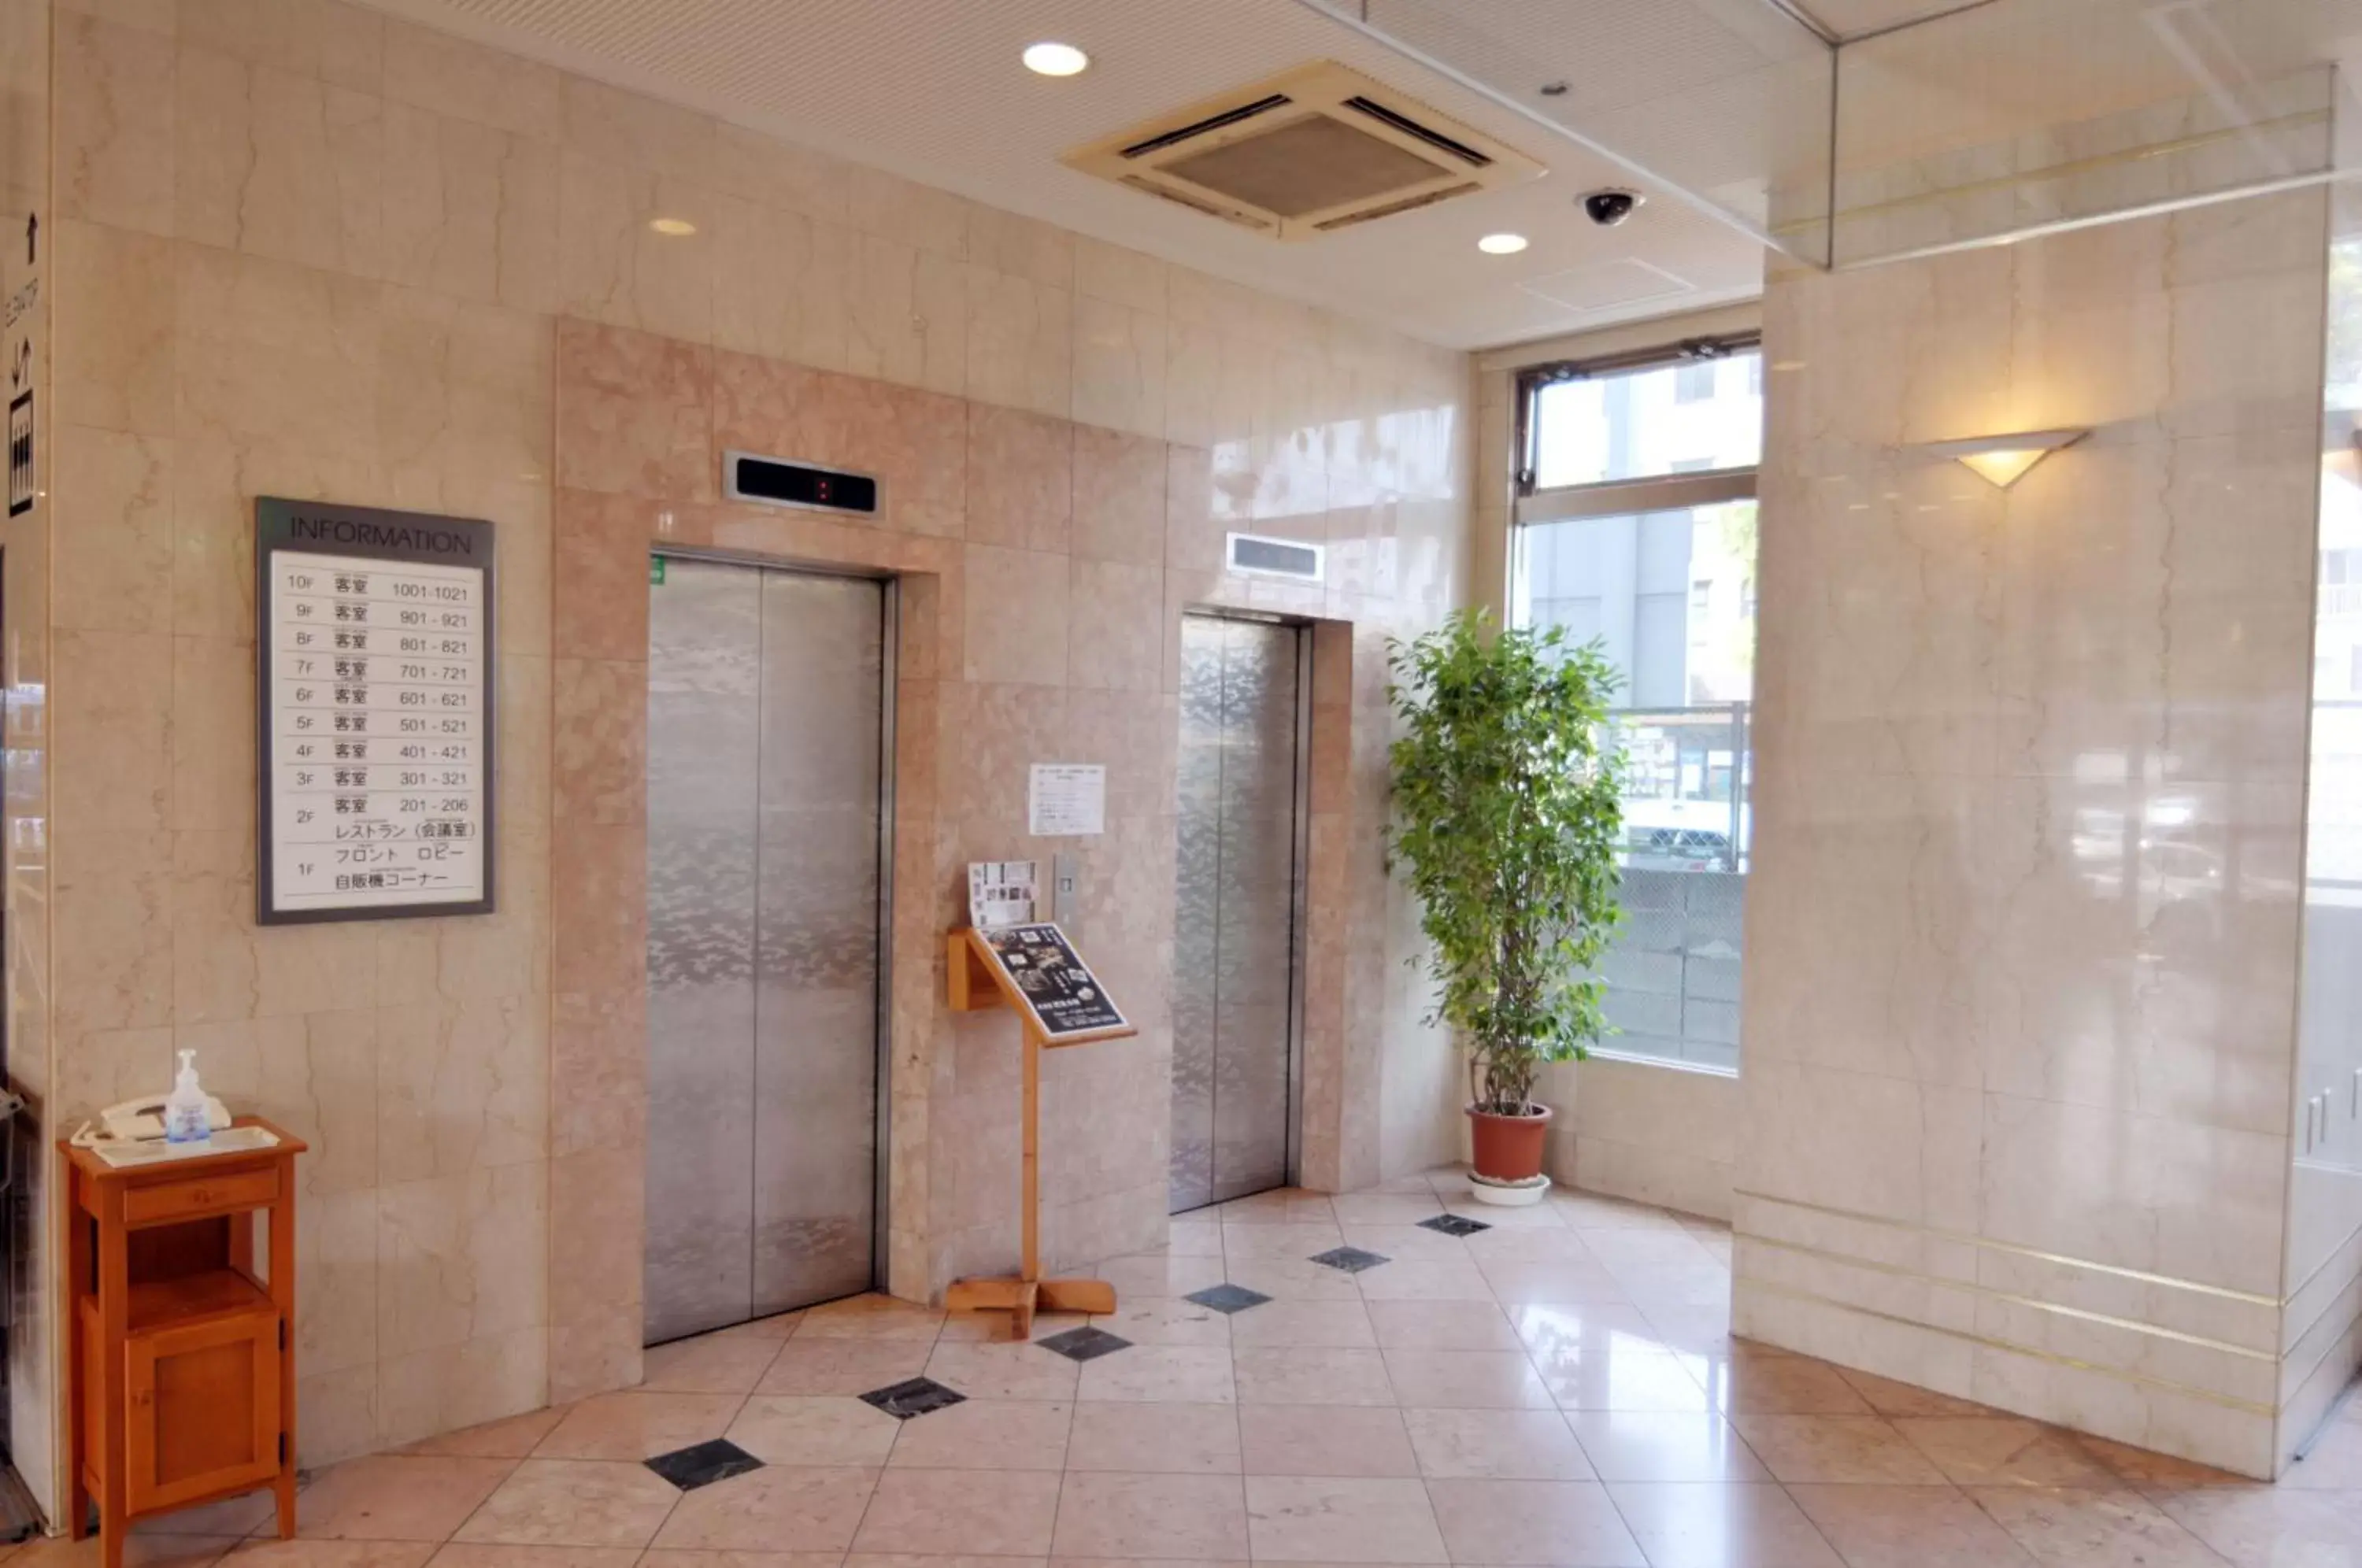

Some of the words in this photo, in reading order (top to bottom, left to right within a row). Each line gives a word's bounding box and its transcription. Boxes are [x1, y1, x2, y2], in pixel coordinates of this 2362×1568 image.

[290, 516, 472, 555] INFORMATION
[288, 575, 314, 589] 10F
[334, 578, 368, 594] 客室
[296, 604, 313, 617] 9F
[335, 605, 368, 621] 客室
[400, 611, 427, 624] 901
[441, 614, 467, 627] 921
[296, 632, 314, 645] 8F
[335, 633, 368, 649] 客室
[400, 638, 427, 652] 801
[441, 640, 467, 654] 821
[295, 660, 314, 675] 7F
[335, 660, 368, 675] 客室
[400, 664, 426, 679] 701
[442, 667, 467, 680] 721
[296, 687, 313, 701] 6F
[335, 688, 368, 704] 客室
[400, 692, 426, 705] 601
[441, 693, 467, 707] 621
[296, 716, 313, 730] 5F
[335, 716, 368, 731] 客室
[400, 718, 426, 731] 501
[441, 719, 467, 733] 521
[296, 744, 313, 756] 4F
[335, 743, 367, 759] 客室
[399, 745, 426, 759] 401
[441, 746, 467, 759] 421
[296, 771, 313, 786] 3F
[335, 771, 367, 786] 客室
[400, 771, 426, 786] 301
[441, 771, 467, 786] 321
[335, 798, 367, 813] 客室
[400, 799, 426, 812] 201
[296, 809, 315, 823] 2F
[336, 849, 398, 864] フロント
[417, 843, 465, 860] ロビー
[298, 863, 314, 875] 1F
